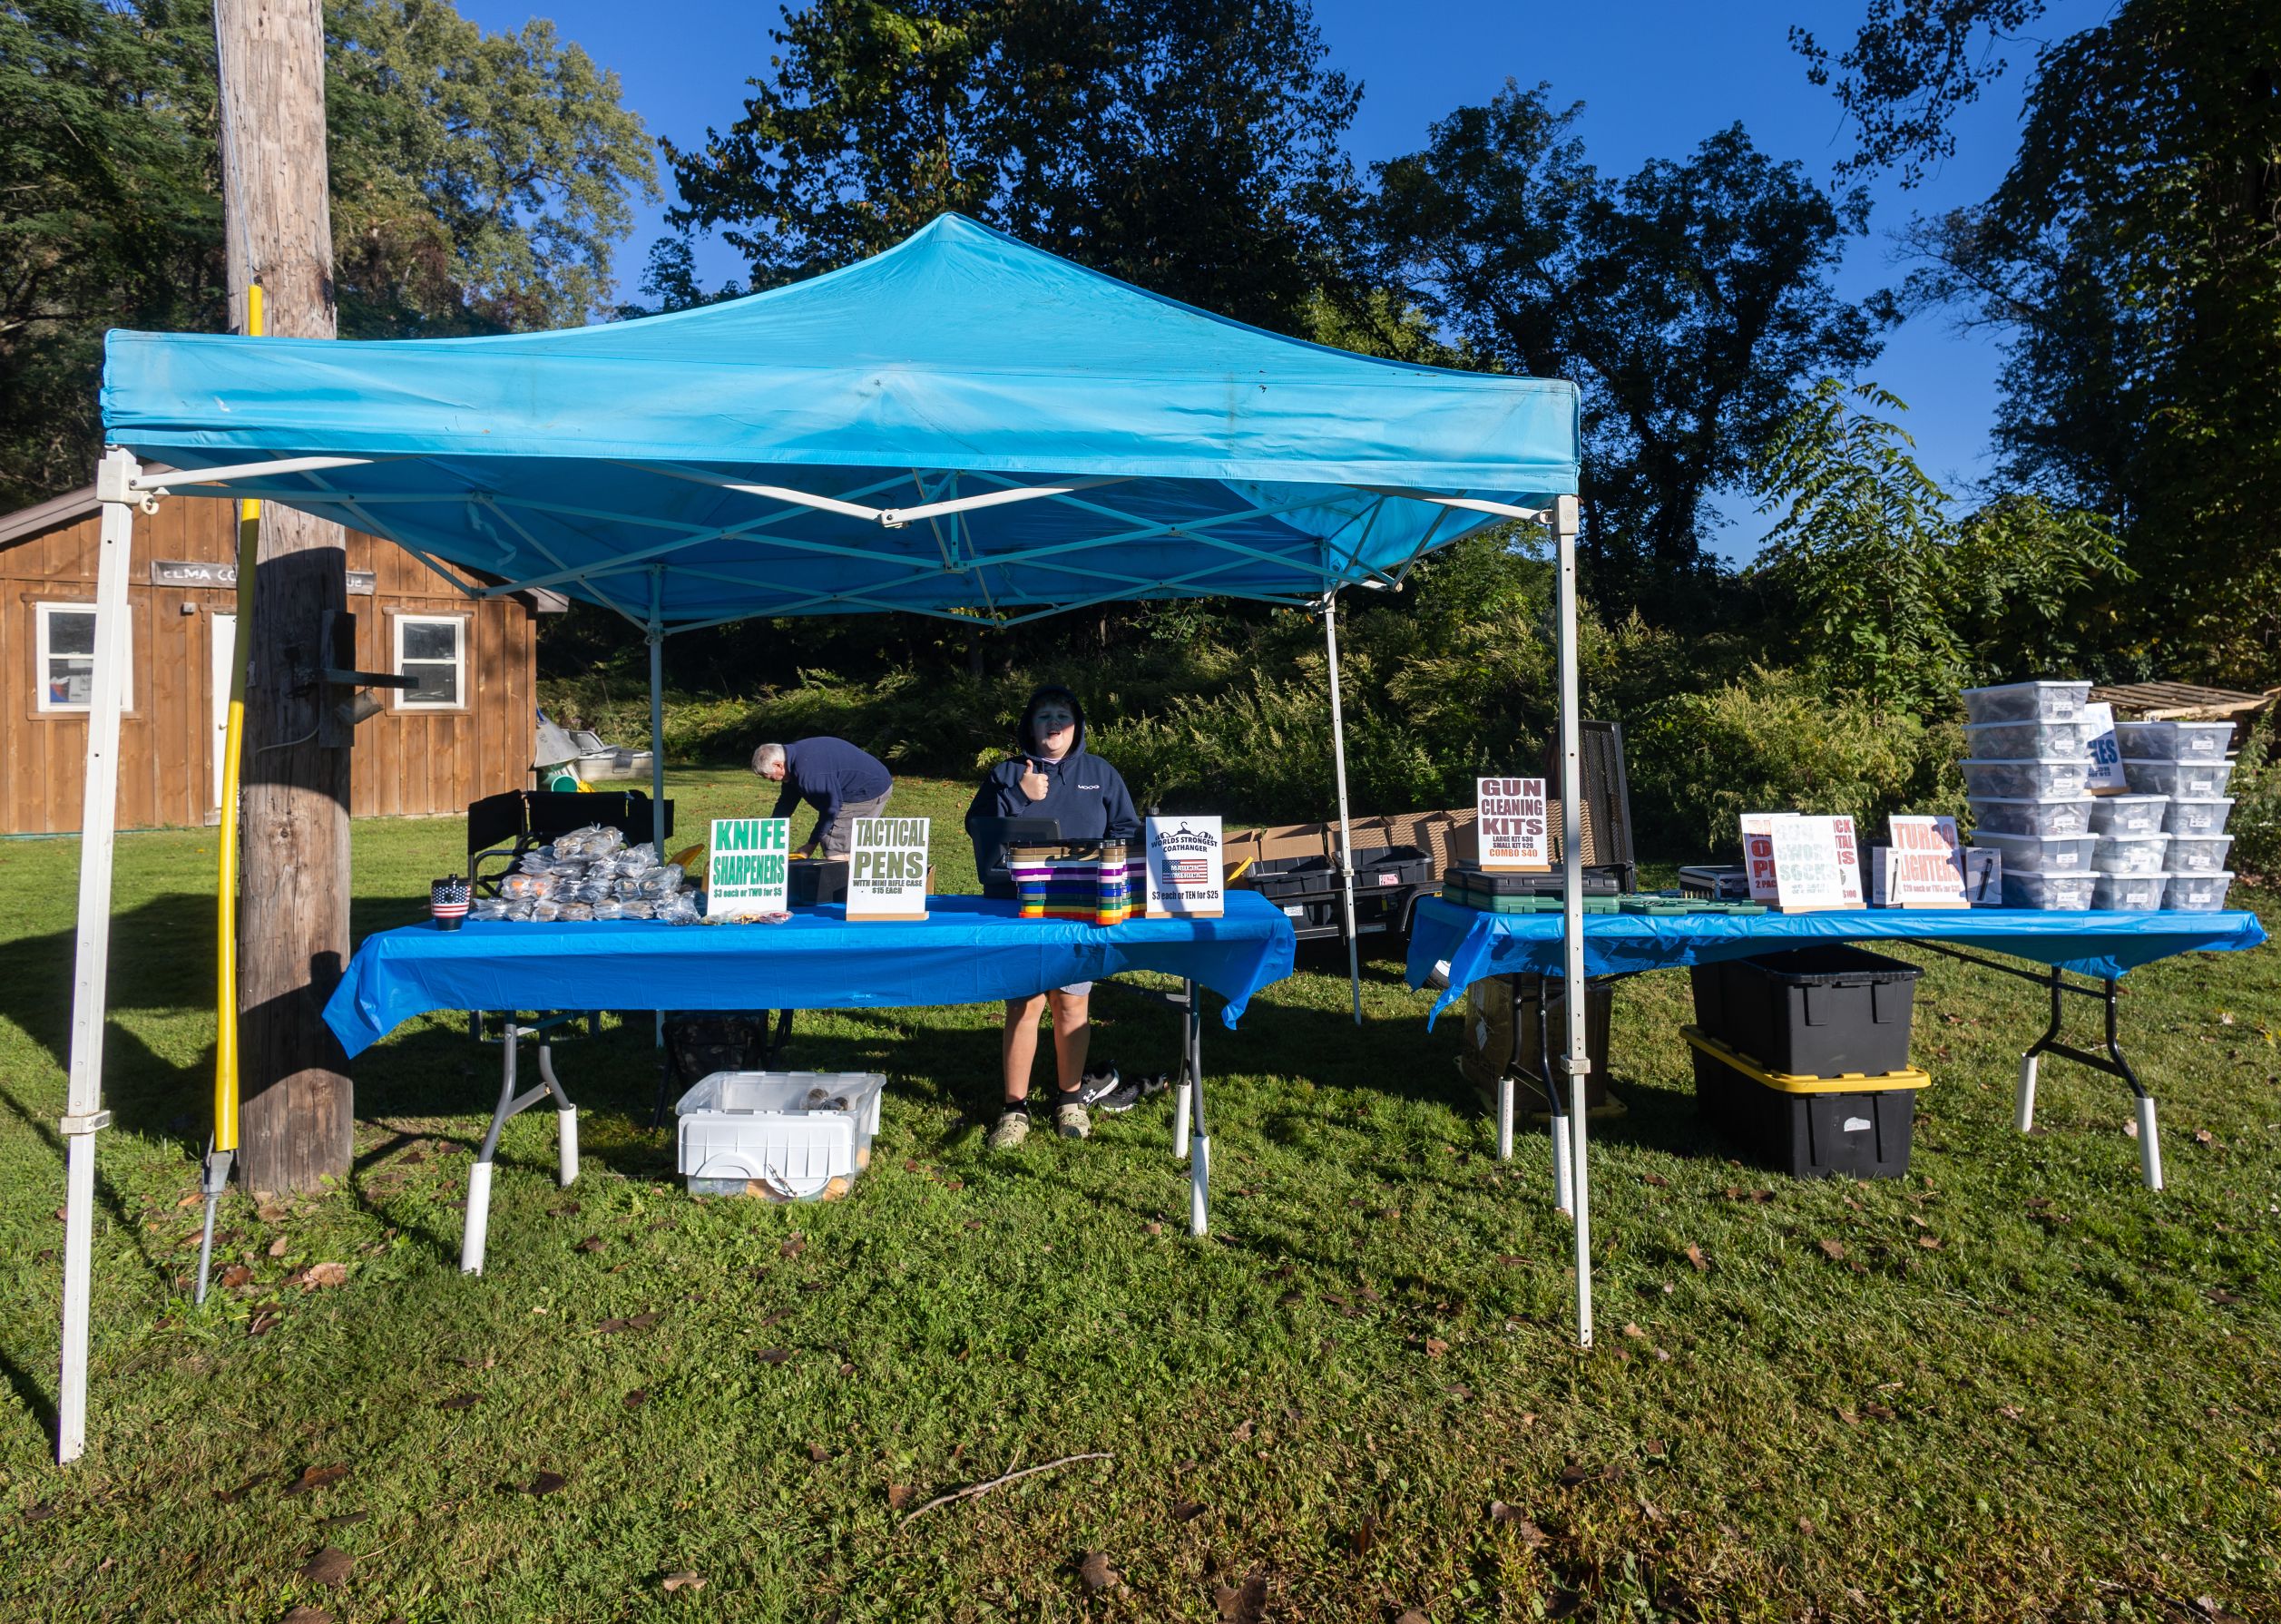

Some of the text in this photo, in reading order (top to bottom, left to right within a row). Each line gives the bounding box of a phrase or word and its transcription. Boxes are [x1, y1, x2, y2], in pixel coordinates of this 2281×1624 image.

[218, 570, 236, 581] CO
[1482, 779, 1542, 797] GUN
[1481, 798, 1542, 816] CLEANING
[715, 819, 786, 851] KNIFE
[857, 819, 925, 847] TACTICAL
[1483, 817, 1543, 836] KITS
[1151, 836, 1218, 848] WORLDS STRONGEST
[1894, 823, 1955, 850] TURBO
[1163, 845, 1208, 853] COATHANGER
[1490, 848, 1519, 856] COMBO
[713, 854, 785, 885] SHARPENERS
[854, 851, 924, 879] PENS
[1901, 855, 1960, 881] LIGHTERS
[713, 886, 782, 898] $3 each or TWO for $5
[1762, 880, 1777, 888] PAC
[1151, 891, 1160, 900] $3
[1161, 891, 1176, 900] each
[1185, 891, 1195, 899] TEN
[1197, 891, 1205, 899] for
[1207, 890, 1219, 899] $25
